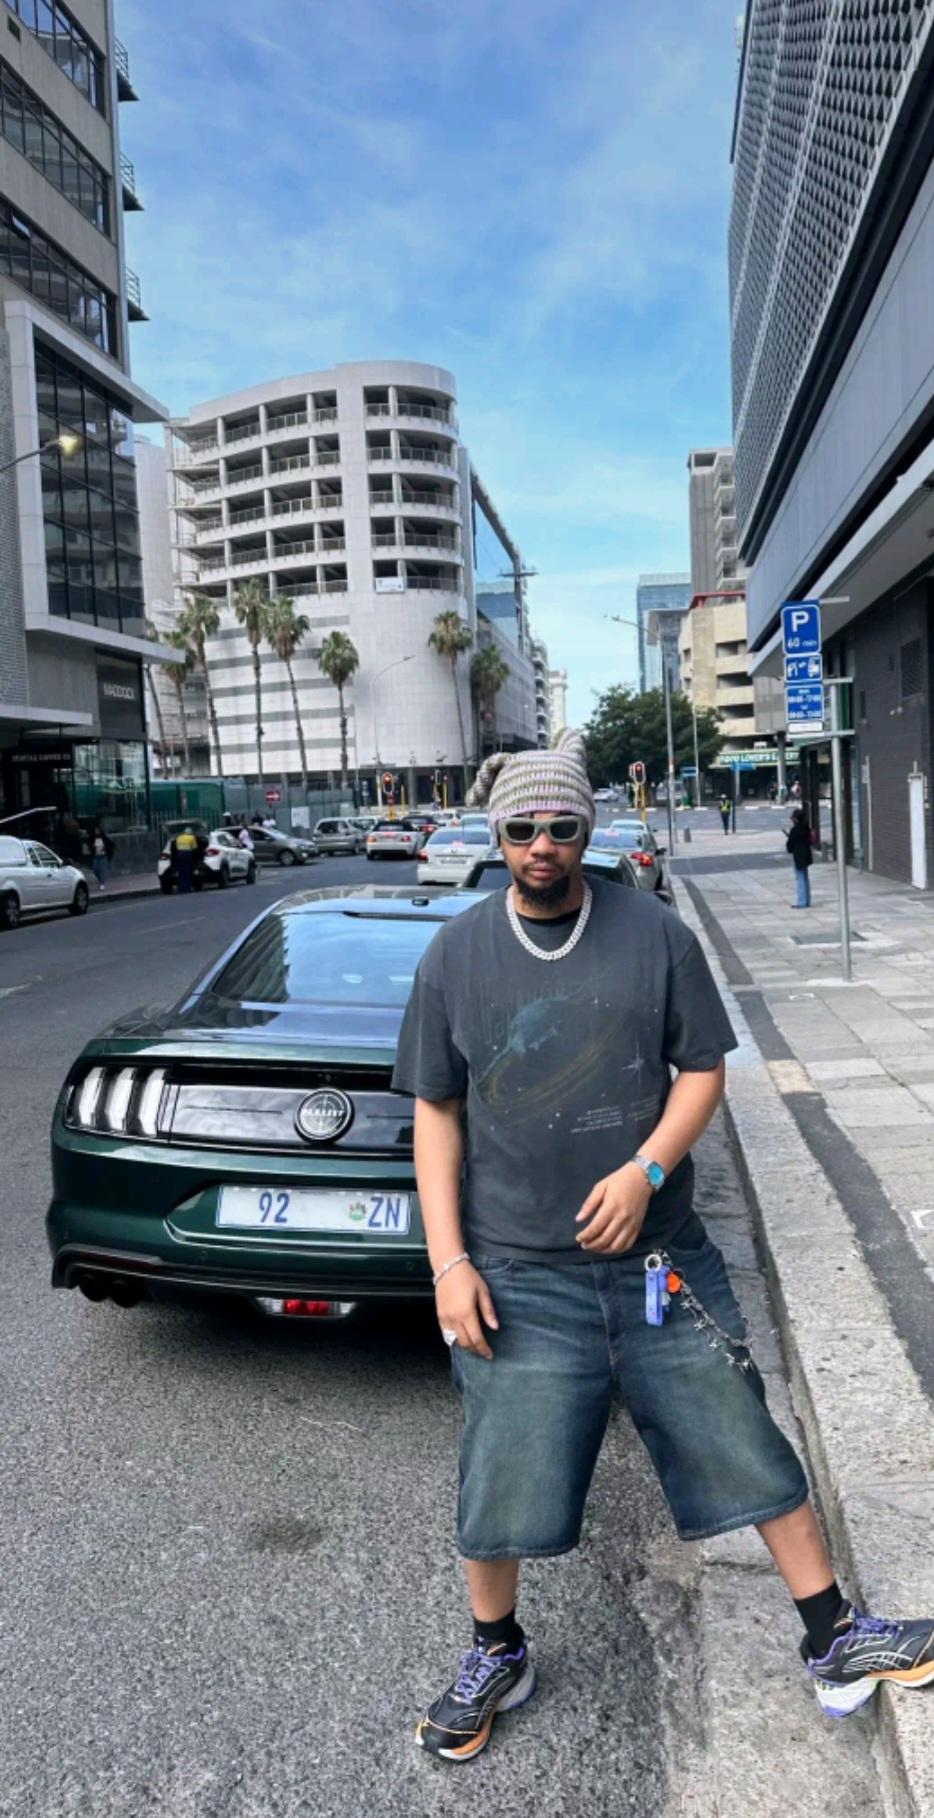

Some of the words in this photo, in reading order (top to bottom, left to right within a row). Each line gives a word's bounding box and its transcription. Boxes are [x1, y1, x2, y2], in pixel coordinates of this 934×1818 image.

[791, 611, 809, 632] P
[787, 637, 800, 648] 60
[259, 1191, 290, 1224] 92
[368, 1196, 401, 1228] ZN
